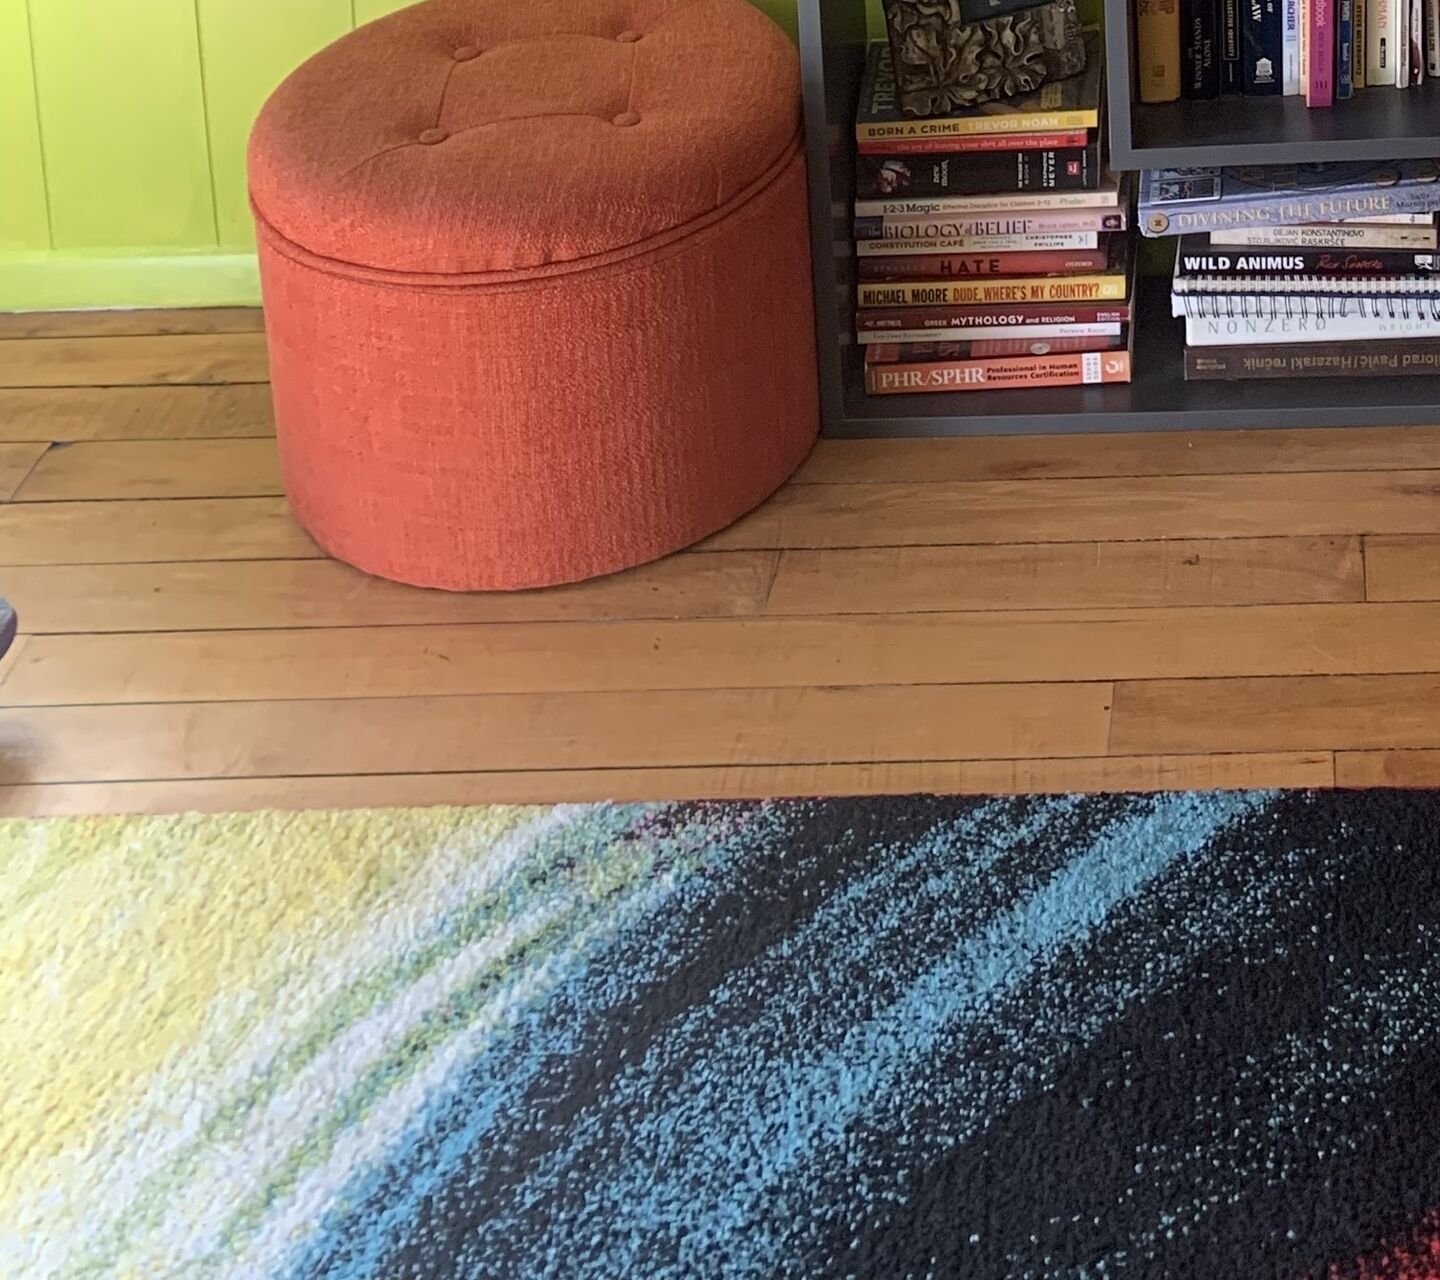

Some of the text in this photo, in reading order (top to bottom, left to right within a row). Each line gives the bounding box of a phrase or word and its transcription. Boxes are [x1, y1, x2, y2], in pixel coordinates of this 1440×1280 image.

[1267, 2, 1274, 14] OF
[867, 117, 1059, 137] BORN A CRIME TREVOR NOAH
[883, 202, 940, 214] 1-2-3 Magic
[1178, 197, 1389, 227] DIVINING THE FUTURE
[884, 219, 1033, 240] BIOLOGY BELIEF
[1301, 229, 1364, 238] KONSTANTINOVO
[868, 240, 938, 250] CONSTITUTION
[939, 238, 964, 248] CAFÉ
[940, 259, 999, 273] HATE
[1183, 256, 1305, 271] WILD ANIMUS
[862, 291, 907, 305] MICHAEL
[911, 288, 948, 303] MOORE
[983, 285, 1026, 300] WHERE'S
[1030, 285, 1044, 299] MY
[1049, 282, 1100, 298] COUNTRY?
[951, 315, 1024, 326] MYTHOLOGY
[1041, 315, 1075, 323] RELIGION
[986, 364, 1036, 373] Professional
[1049, 362, 1078, 370] Human
[1242, 356, 1287, 371] rečnik
[881, 367, 985, 388] PHR/SPHR
[986, 370, 1080, 381] Resources Certification
